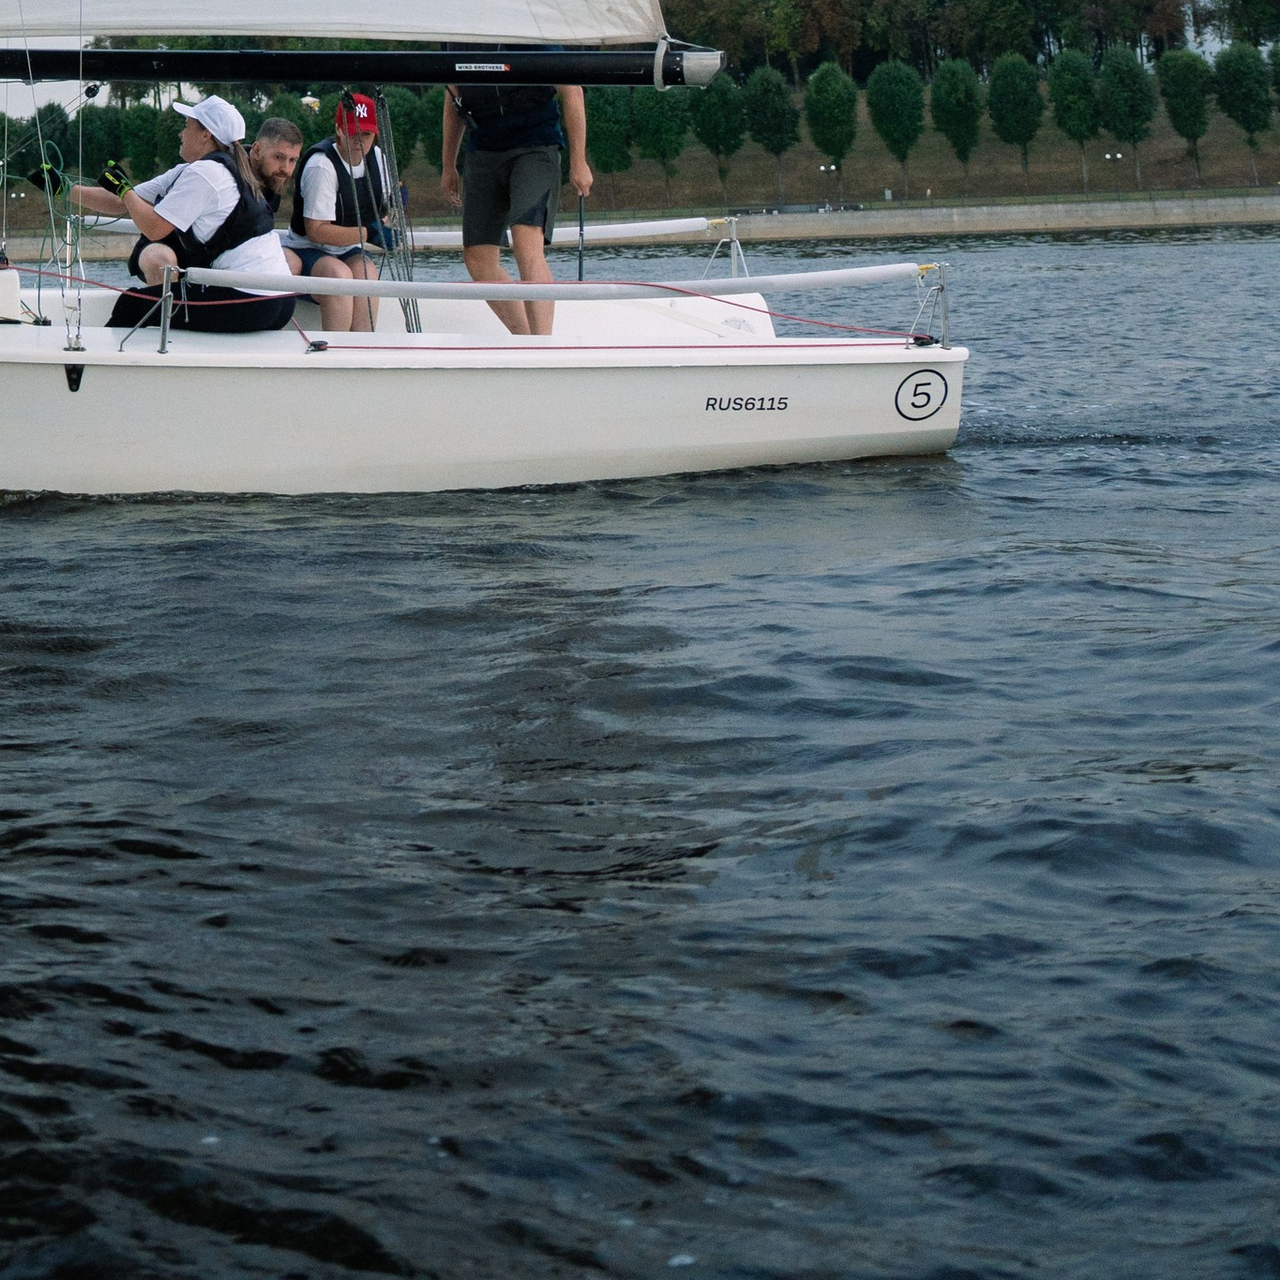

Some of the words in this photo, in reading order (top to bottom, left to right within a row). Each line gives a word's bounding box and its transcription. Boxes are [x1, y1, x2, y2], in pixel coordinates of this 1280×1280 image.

[356, 103, 368, 118] NY
[910, 382, 932, 409] 5
[705, 397, 789, 411] RUS6115
